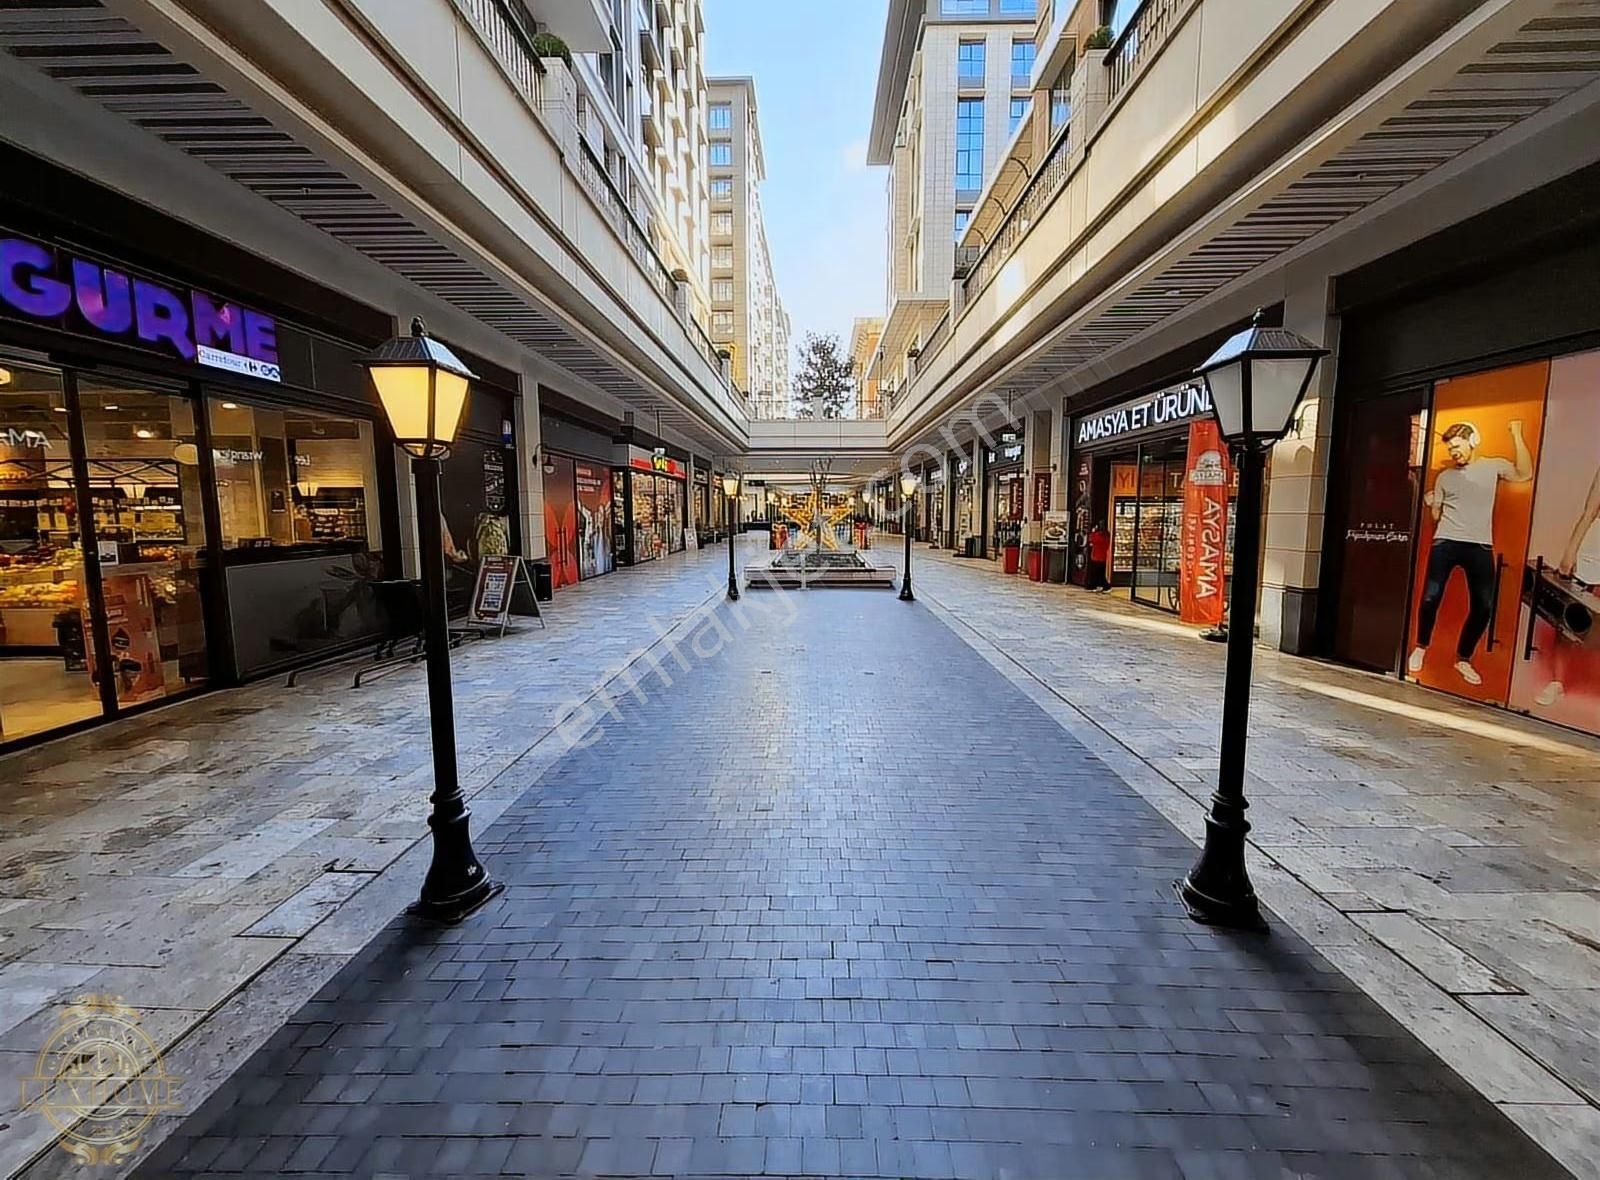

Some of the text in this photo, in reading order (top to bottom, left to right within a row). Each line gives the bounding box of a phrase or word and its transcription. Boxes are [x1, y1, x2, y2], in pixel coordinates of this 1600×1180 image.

[0, 238, 279, 363] GURME
[1078, 410, 1129, 443] AMASYA
[1131, 402, 1151, 430] ET
